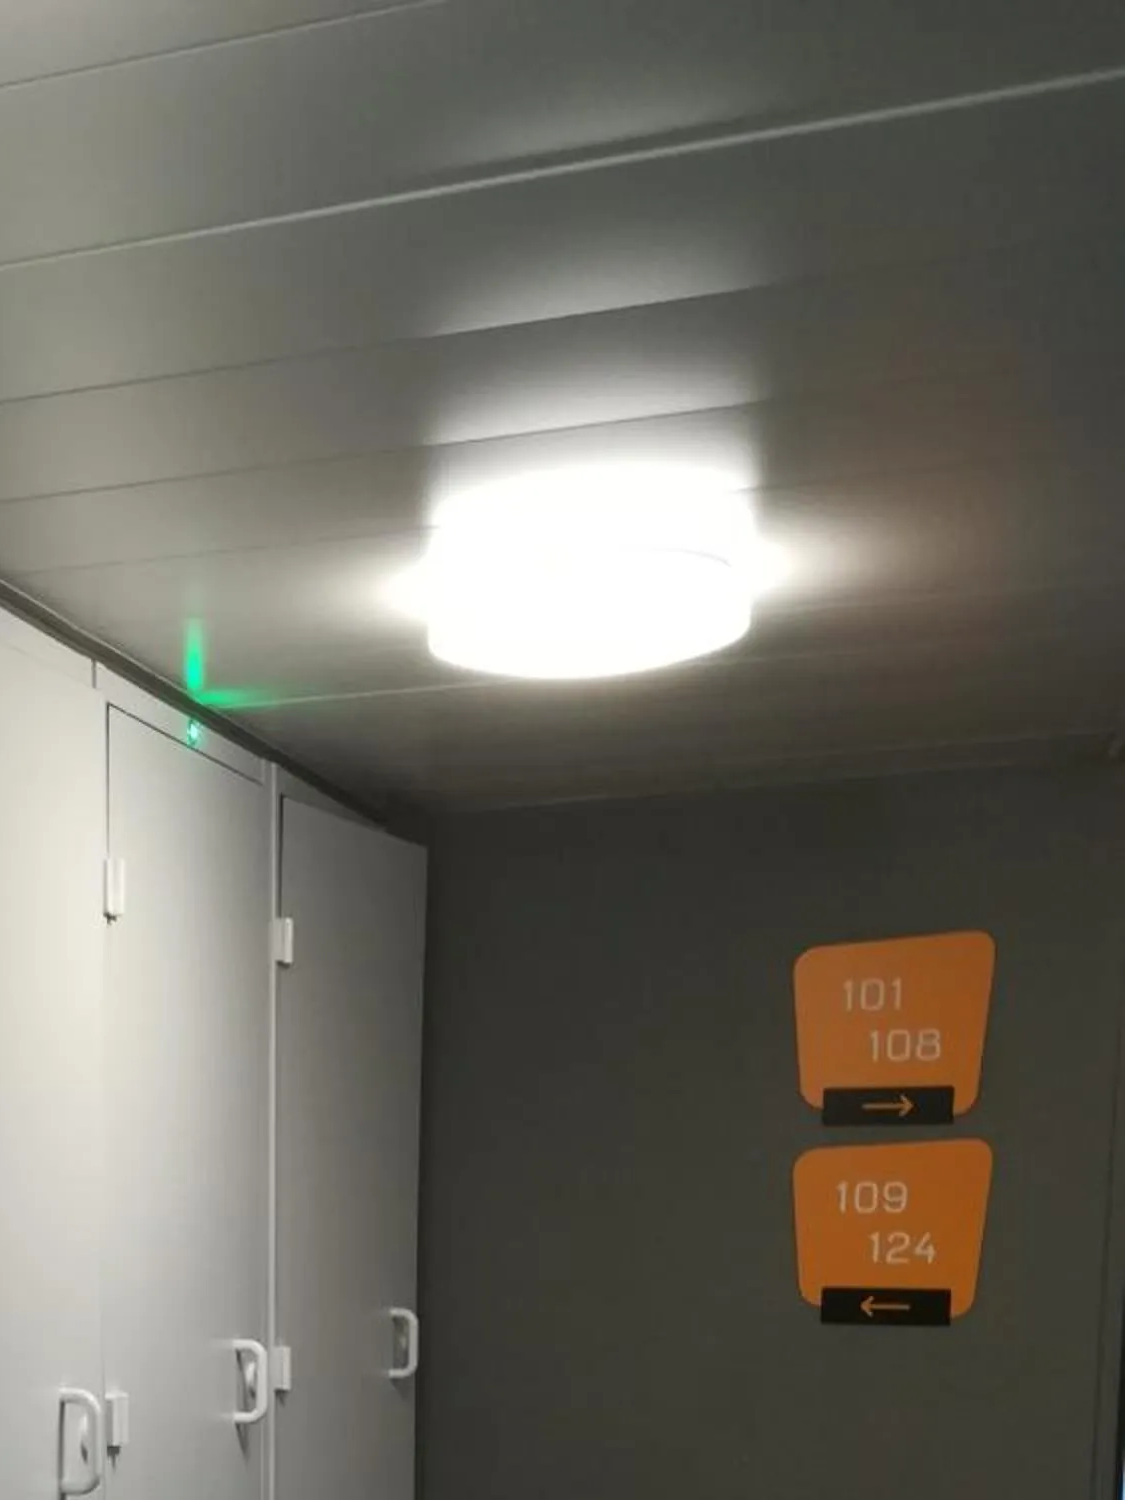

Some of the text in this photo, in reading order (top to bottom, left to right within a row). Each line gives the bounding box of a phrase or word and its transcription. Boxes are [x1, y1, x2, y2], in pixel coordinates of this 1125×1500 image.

[843, 976, 902, 1012] 101
[870, 1028, 941, 1062] 108
[836, 1180, 908, 1214] 109
[868, 1231, 936, 1264] 124
